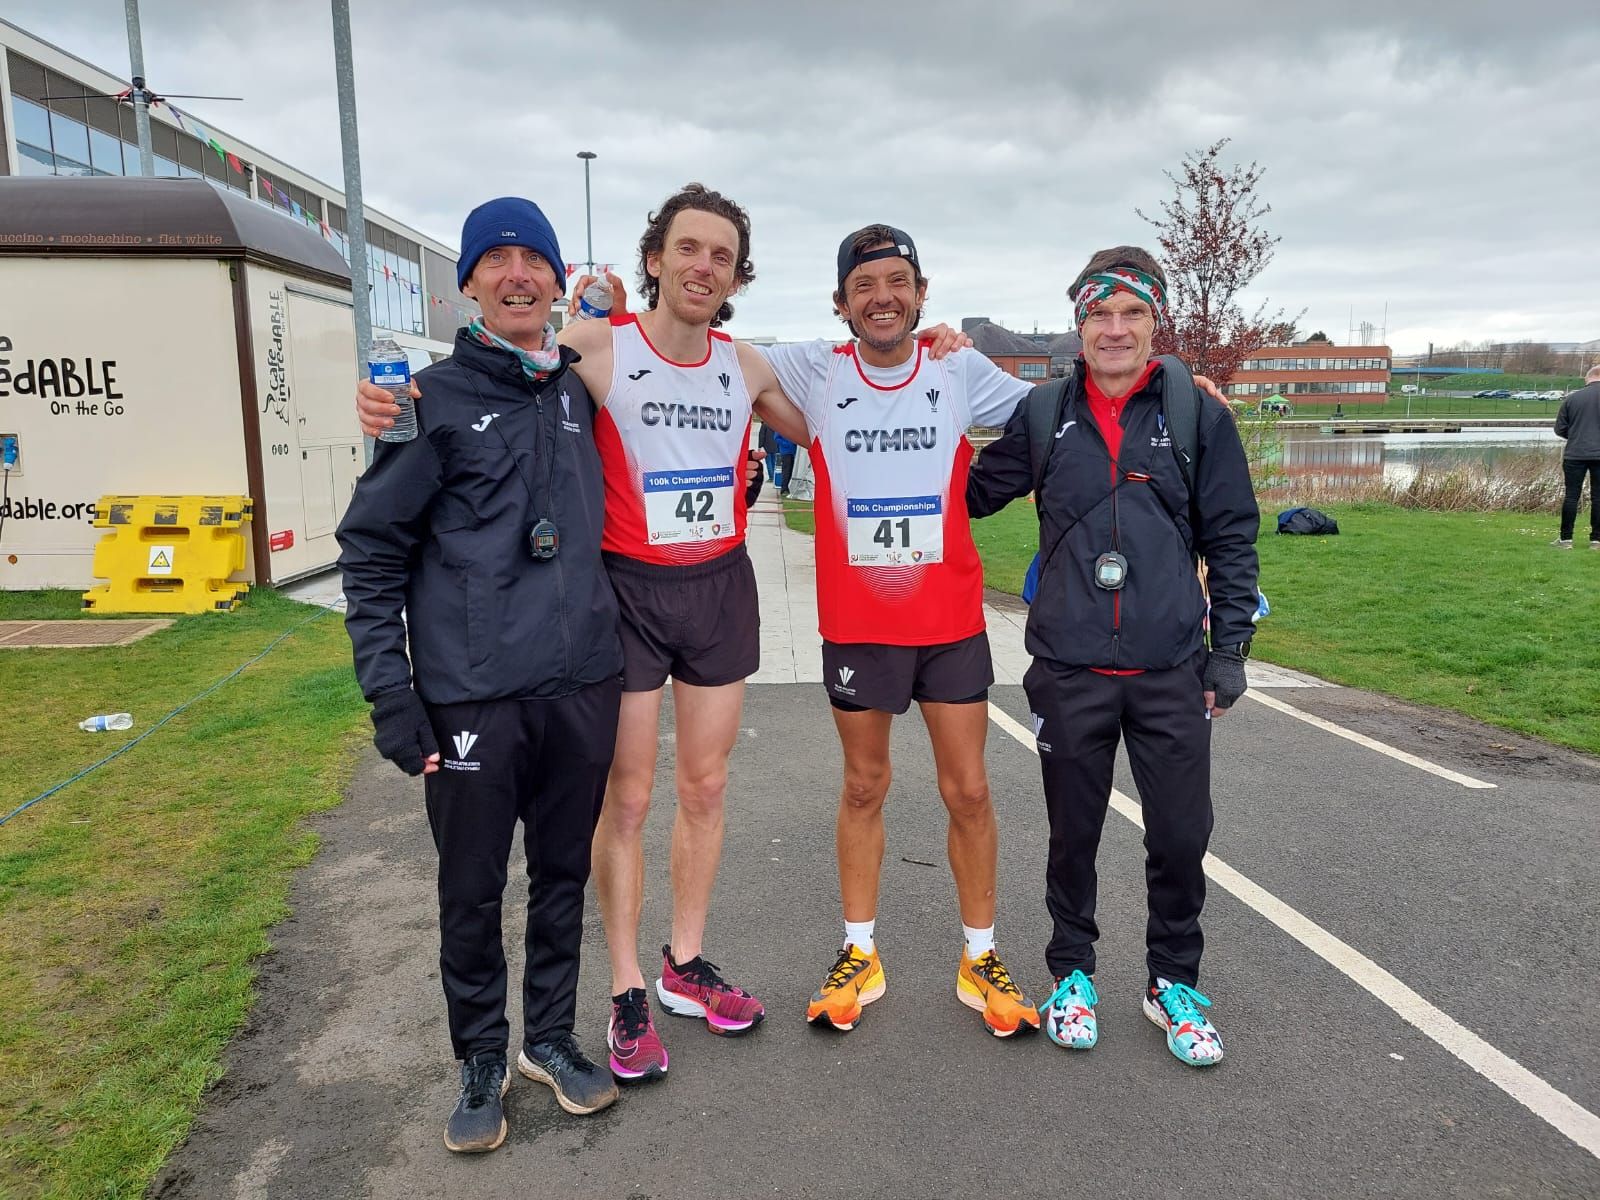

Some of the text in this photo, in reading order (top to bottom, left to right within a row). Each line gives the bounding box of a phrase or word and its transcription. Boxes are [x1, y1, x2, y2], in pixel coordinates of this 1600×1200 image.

[0, 233, 223, 245] uccino mochachino flat white
[50, 400, 124, 416] On the Go
[641, 401, 732, 432] CYMRU
[844, 426, 937, 453] CYMRU
[649, 473, 730, 486] 100k Championships
[675, 491, 715, 522] 42
[852, 502, 936, 513] 100k Championships
[873, 518, 910, 548] 41
